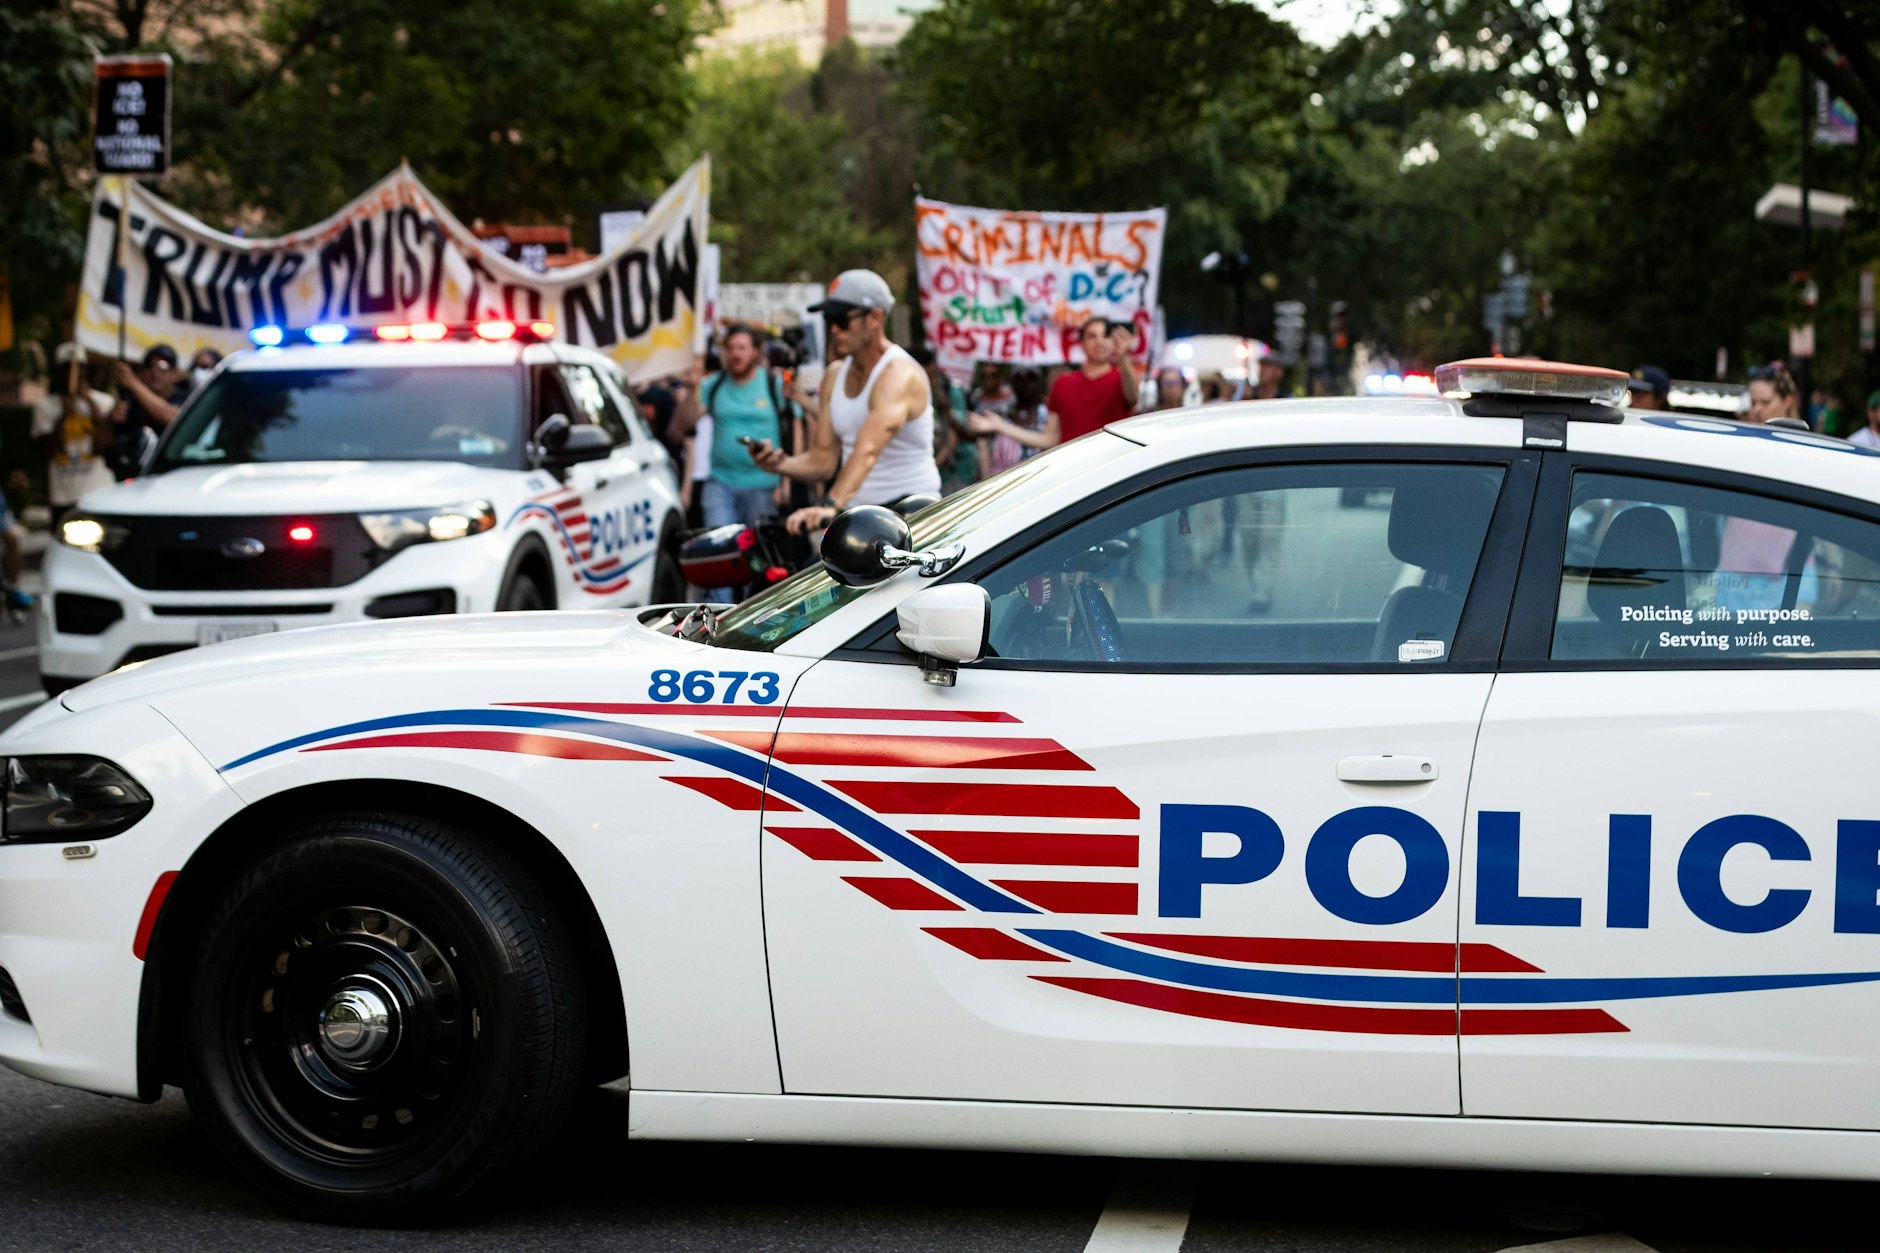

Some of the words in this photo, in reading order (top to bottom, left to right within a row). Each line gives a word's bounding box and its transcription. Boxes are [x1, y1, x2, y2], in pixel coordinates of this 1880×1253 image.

[98, 198, 304, 332] TRUMP
[318, 206, 446, 321] MUST
[562, 218, 699, 348] NOW
[933, 264, 1010, 297] OUT
[590, 500, 654, 558] POLICE
[1620, 605, 1694, 624] Policing
[1697, 606, 1732, 622] with
[1736, 609, 1814, 624] purpose.
[1659, 631, 1730, 650] Serving
[1734, 633, 1768, 648] with
[1772, 633, 1815, 648] care.
[648, 669, 780, 705] 8673
